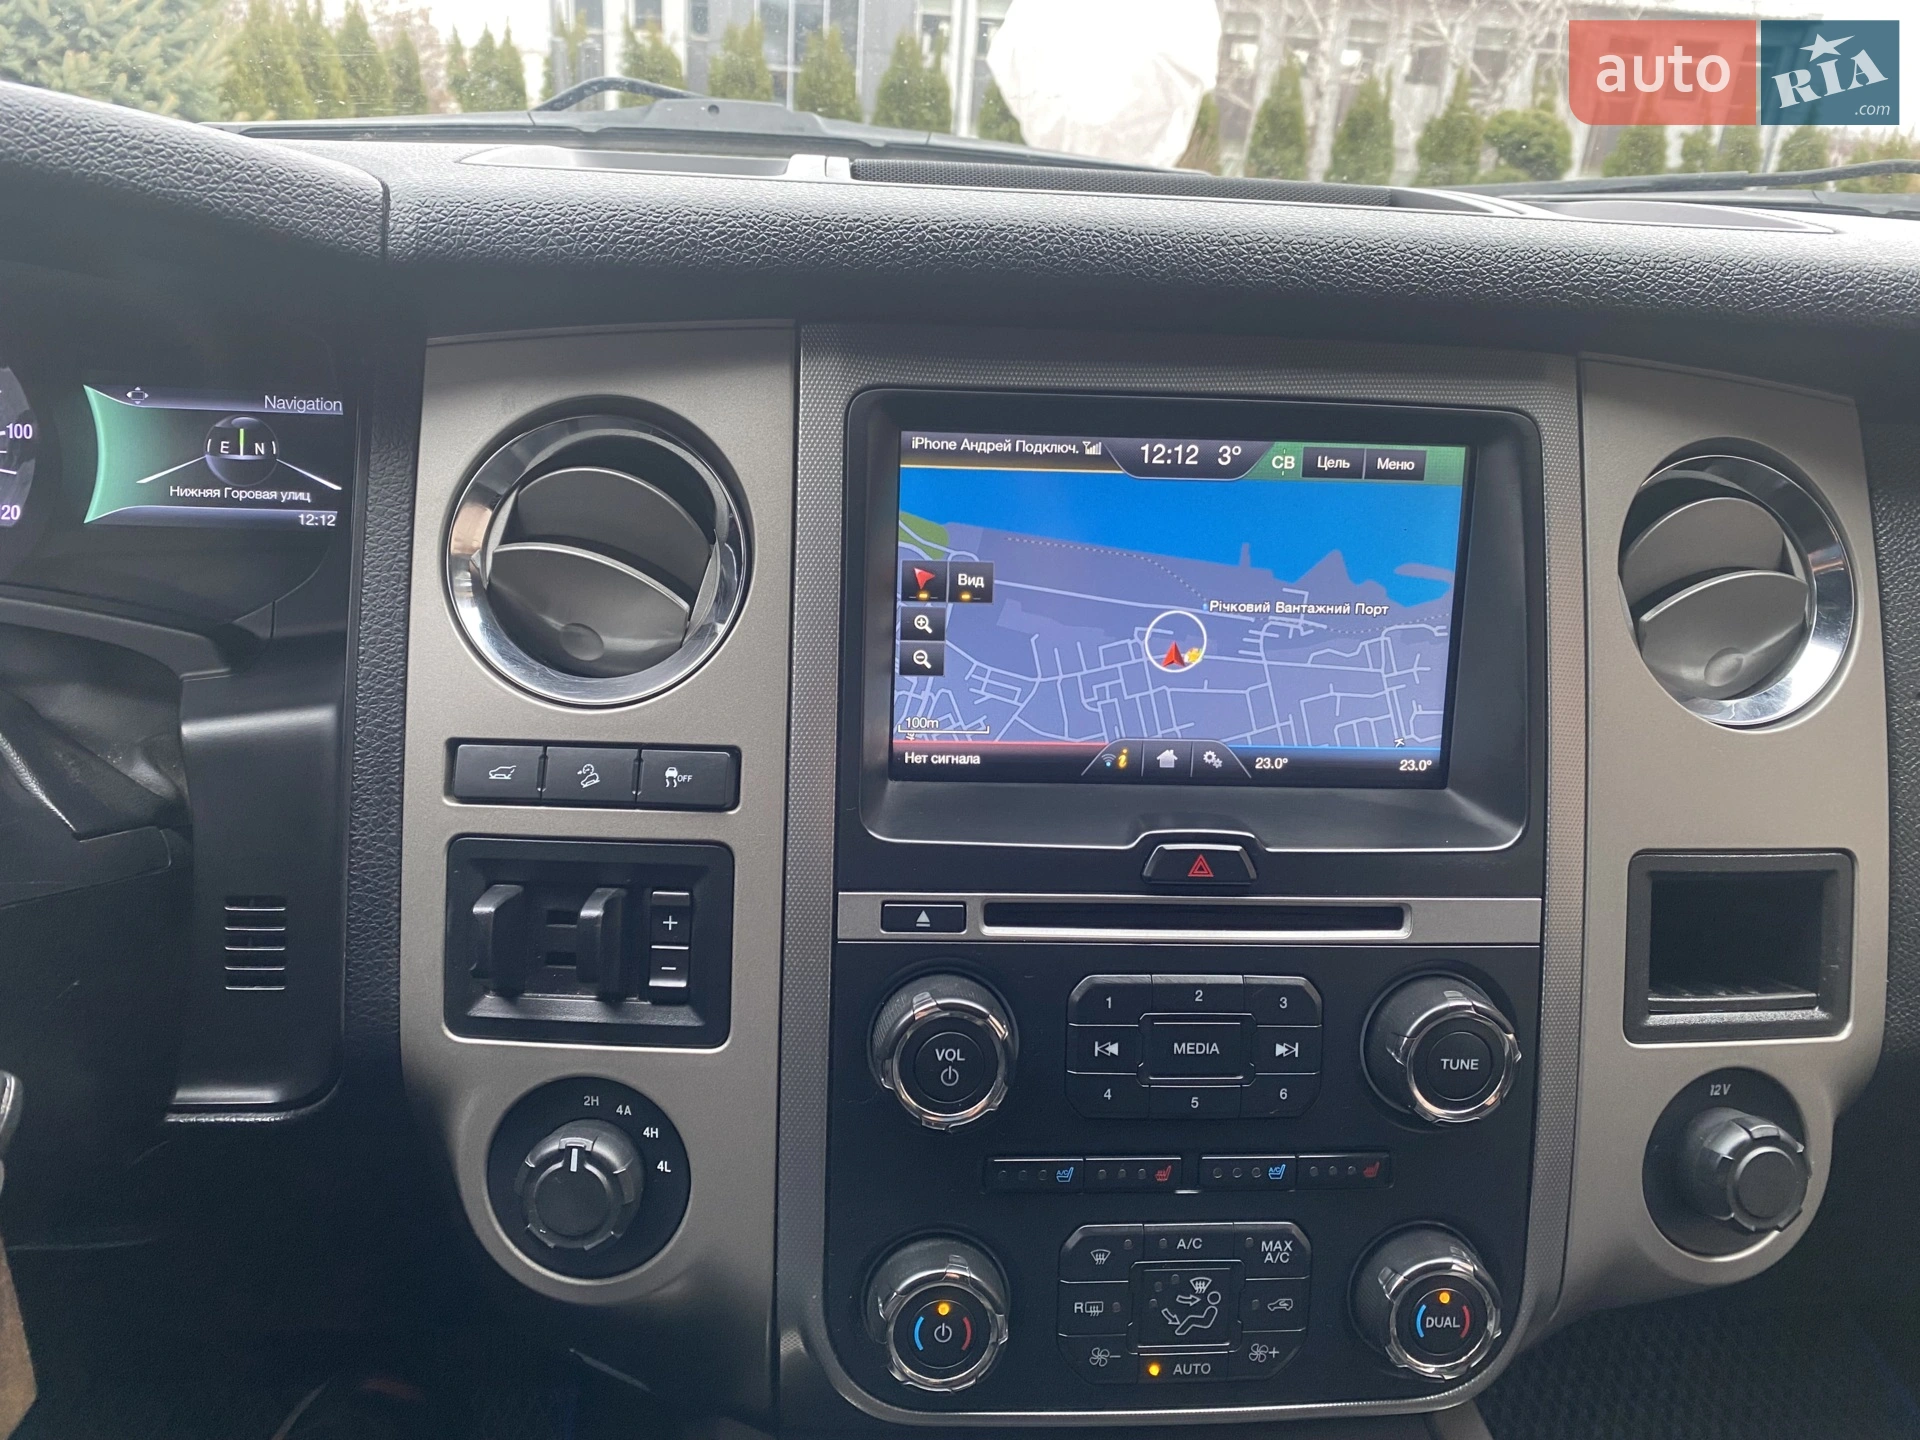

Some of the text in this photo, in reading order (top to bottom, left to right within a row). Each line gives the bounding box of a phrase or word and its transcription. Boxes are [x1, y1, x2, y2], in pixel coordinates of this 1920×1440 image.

[264, 395, 343, 413] Navigation
[6, 423, 33, 440] 100
[220, 441, 265, 455] E N
[911, 436, 1079, 455] iPhone Андрей Подключ.
[1140, 443, 1199, 465] 12:12
[1317, 455, 1351, 470] Цель
[1376, 458, 1415, 471] Меню
[169, 486, 311, 503] Нижняя Горовая улиц
[298, 513, 336, 527] 12:12
[957, 573, 985, 588] Вид
[1209, 600, 1389, 616] Річковий Вантажний Порт
[905, 717, 939, 730] 100m
[904, 752, 981, 766] Нет сигнала
[1255, 757, 1289, 770] 23.0°
[1399, 759, 1433, 772] 23.0°
[677, 774, 692, 783] OFF
[1194, 989, 1203, 1002] 2
[1105, 996, 1112, 1009] 1
[1279, 996, 1288, 1009] 3
[935, 1048, 966, 1062] VOL
[1173, 1042, 1220, 1055] MEDIA
[1440, 1058, 1479, 1070] TUNE
[1103, 1088, 1112, 1100] 4
[1279, 1088, 1288, 1100] 6
[583, 1096, 600, 1106] 2H
[1190, 1097, 1199, 1109] 5
[616, 1105, 632, 1116] 4A
[642, 1127, 659, 1138] 4H
[656, 1161, 672, 1172] 4L
[1176, 1238, 1203, 1249] A/C
[1261, 1241, 1293, 1252] MAX
[1263, 1252, 1290, 1263] A/C
[1074, 1302, 1084, 1313] R
[1425, 1316, 1461, 1328] DUAL
[1173, 1364, 1211, 1375] AUTO
